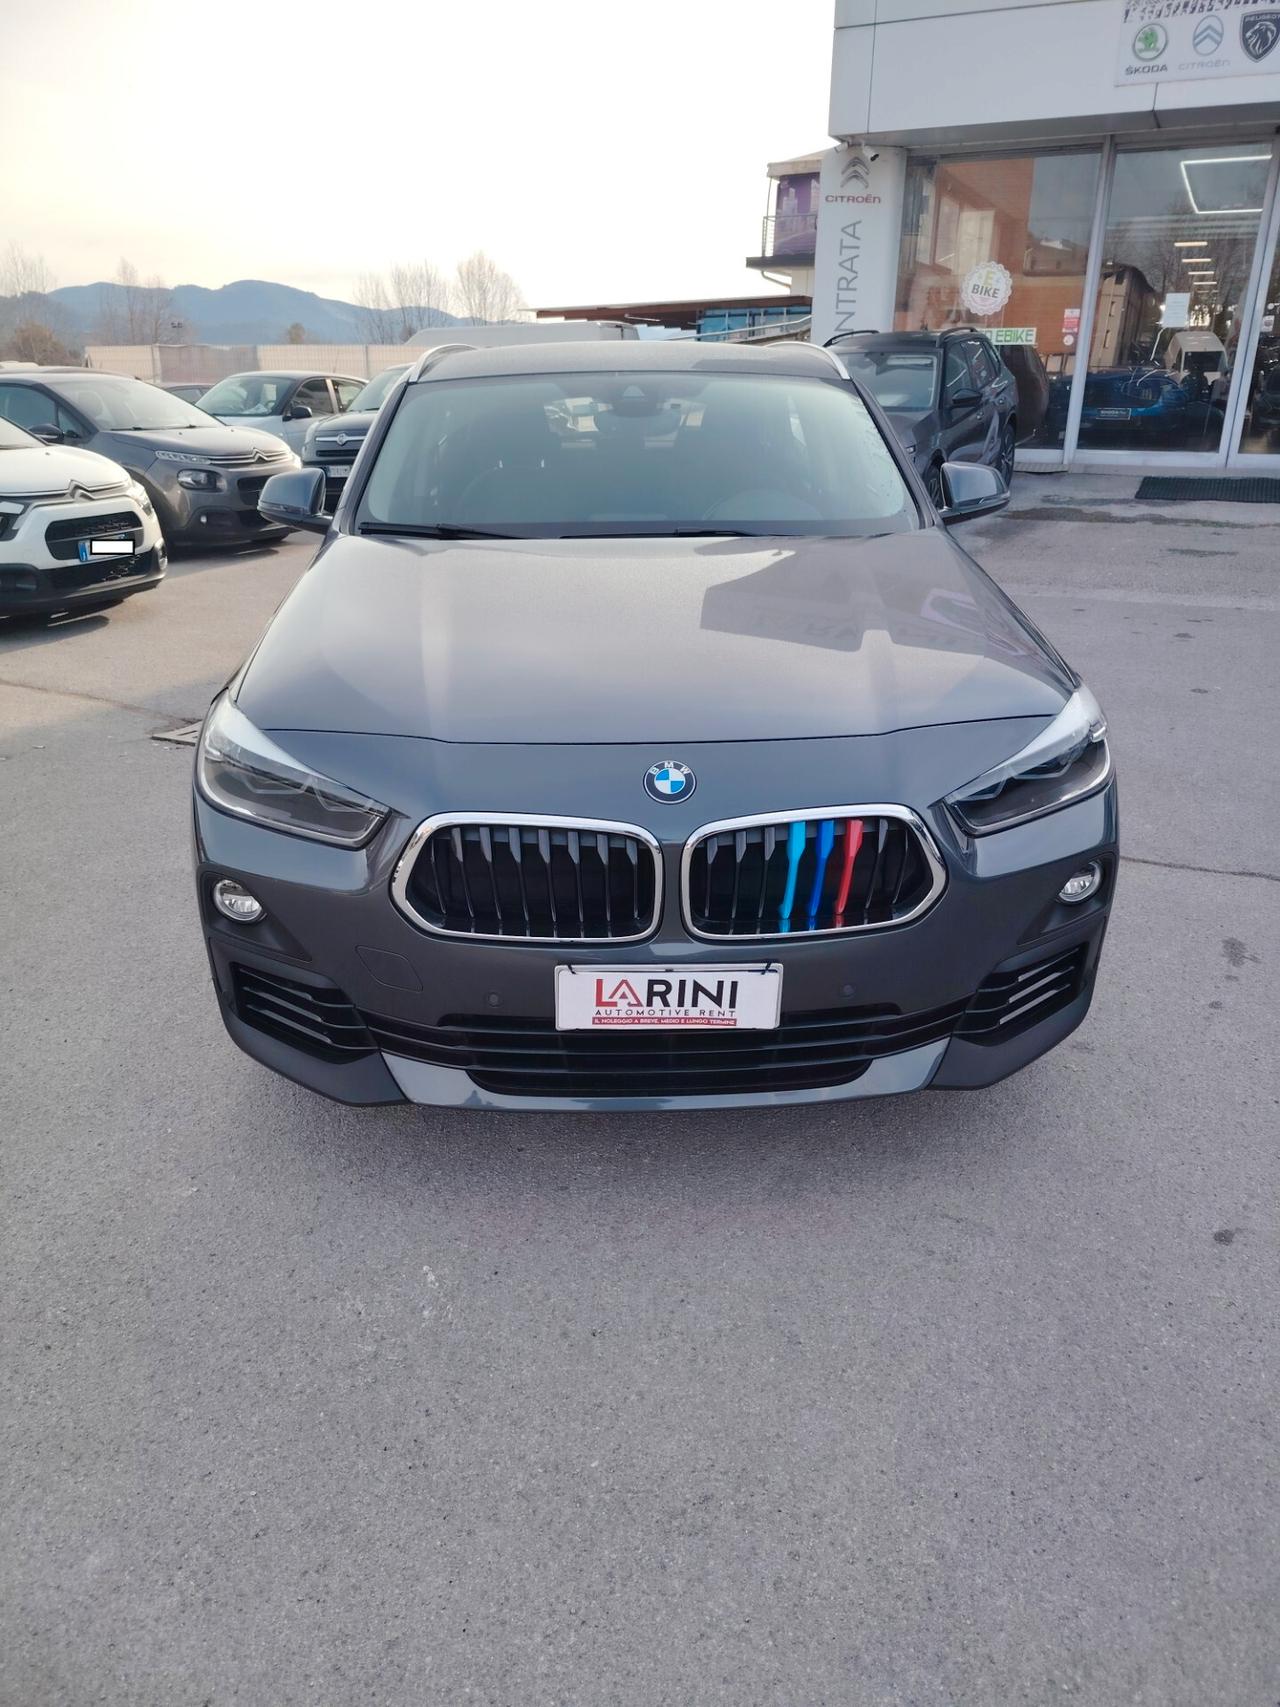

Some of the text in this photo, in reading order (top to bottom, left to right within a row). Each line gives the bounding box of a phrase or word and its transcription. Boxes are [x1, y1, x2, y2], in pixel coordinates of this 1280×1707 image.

[834, 220, 862, 336] NTRATA
[971, 284, 1000, 298] BIKE
[995, 329, 1034, 343] EBIKE
[649, 761, 691, 775] BMW
[595, 978, 739, 1009] LARINI
[699, 1009, 736, 1017] RENT
